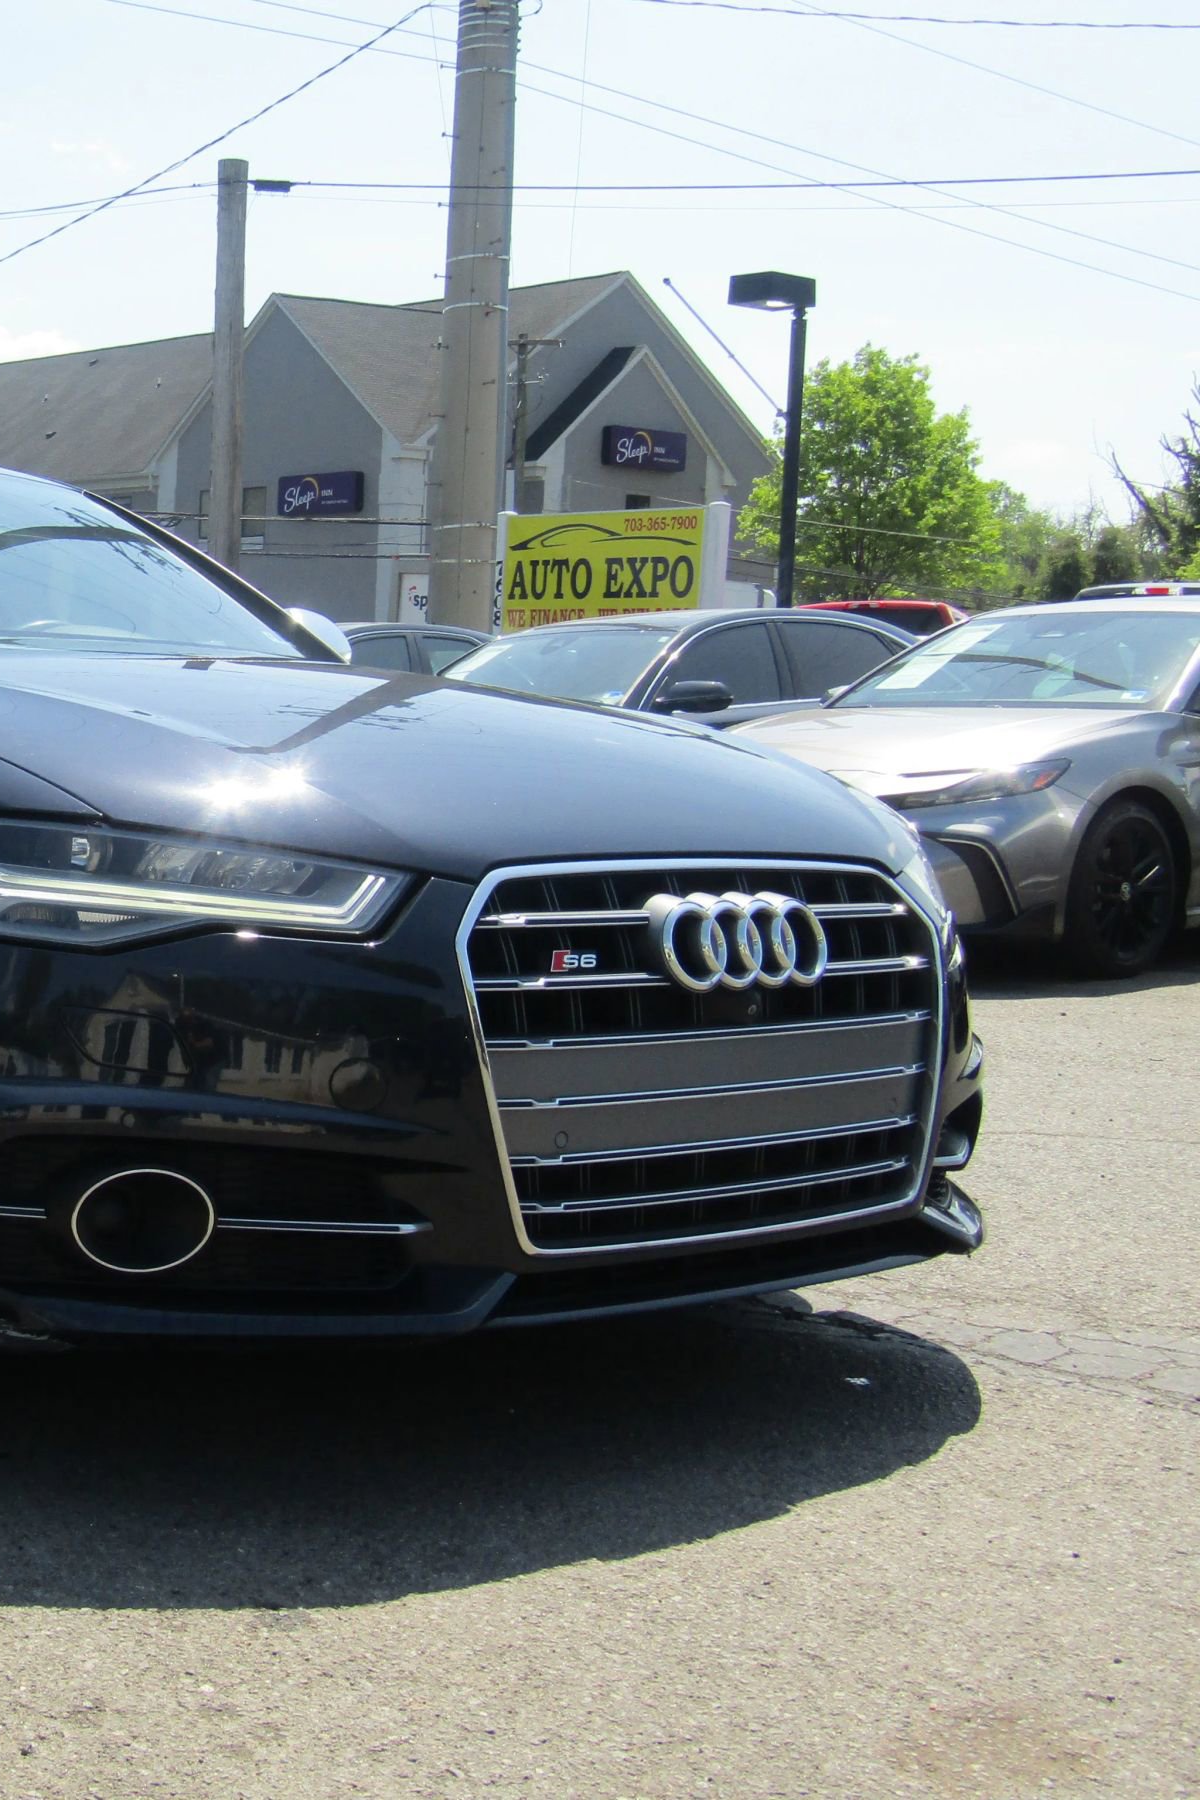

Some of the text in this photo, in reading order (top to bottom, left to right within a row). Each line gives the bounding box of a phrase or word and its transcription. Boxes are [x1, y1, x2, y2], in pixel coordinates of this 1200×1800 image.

[616, 438, 648, 463] Sleep
[284, 486, 315, 513] Sleep
[623, 515, 698, 532] 703-365-7900
[507, 555, 695, 600] AUTO EXPO
[507, 608, 526, 627] WE
[562, 954, 597, 968] S6
